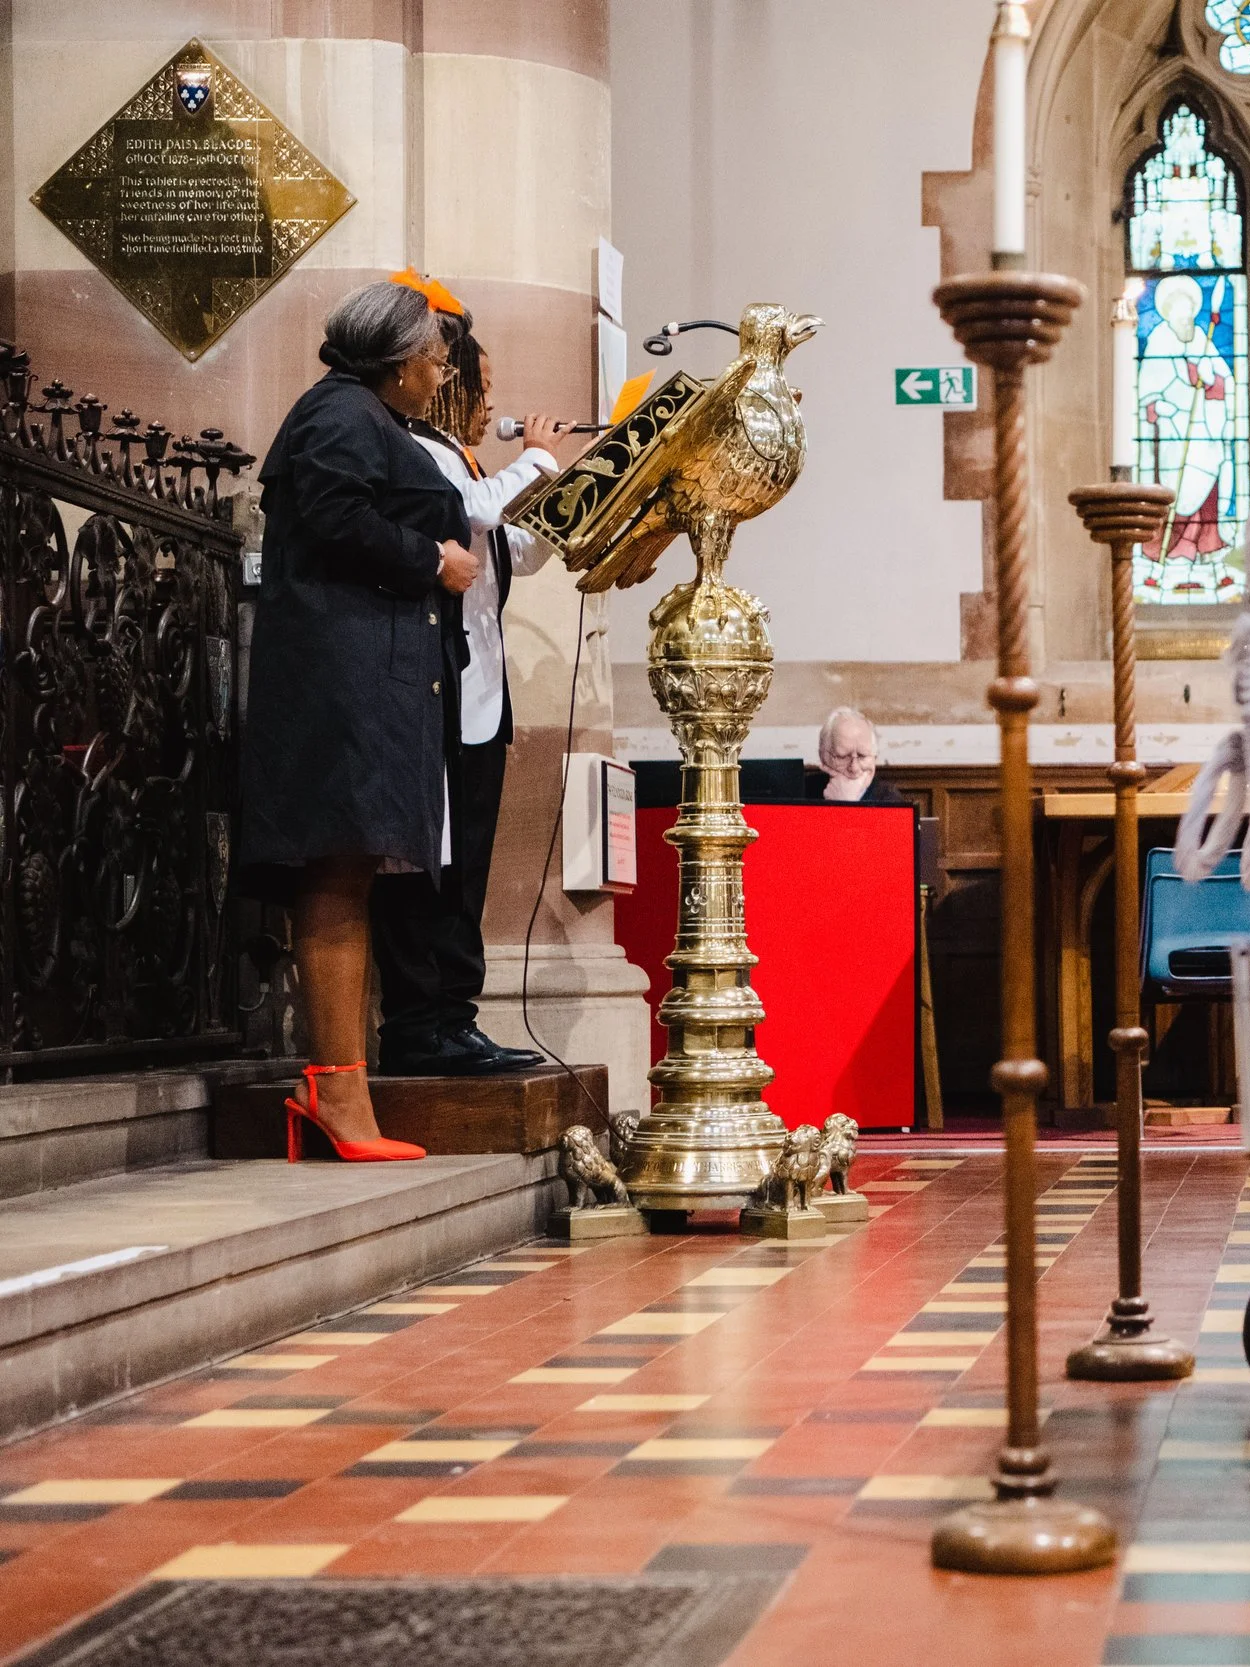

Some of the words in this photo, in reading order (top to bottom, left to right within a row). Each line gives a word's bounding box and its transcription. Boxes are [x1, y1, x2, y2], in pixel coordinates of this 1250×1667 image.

[126, 139, 162, 150] EDITH
[166, 139, 199, 150] DAISY
[119, 175, 142, 186] This
[145, 176, 177, 186] tablet
